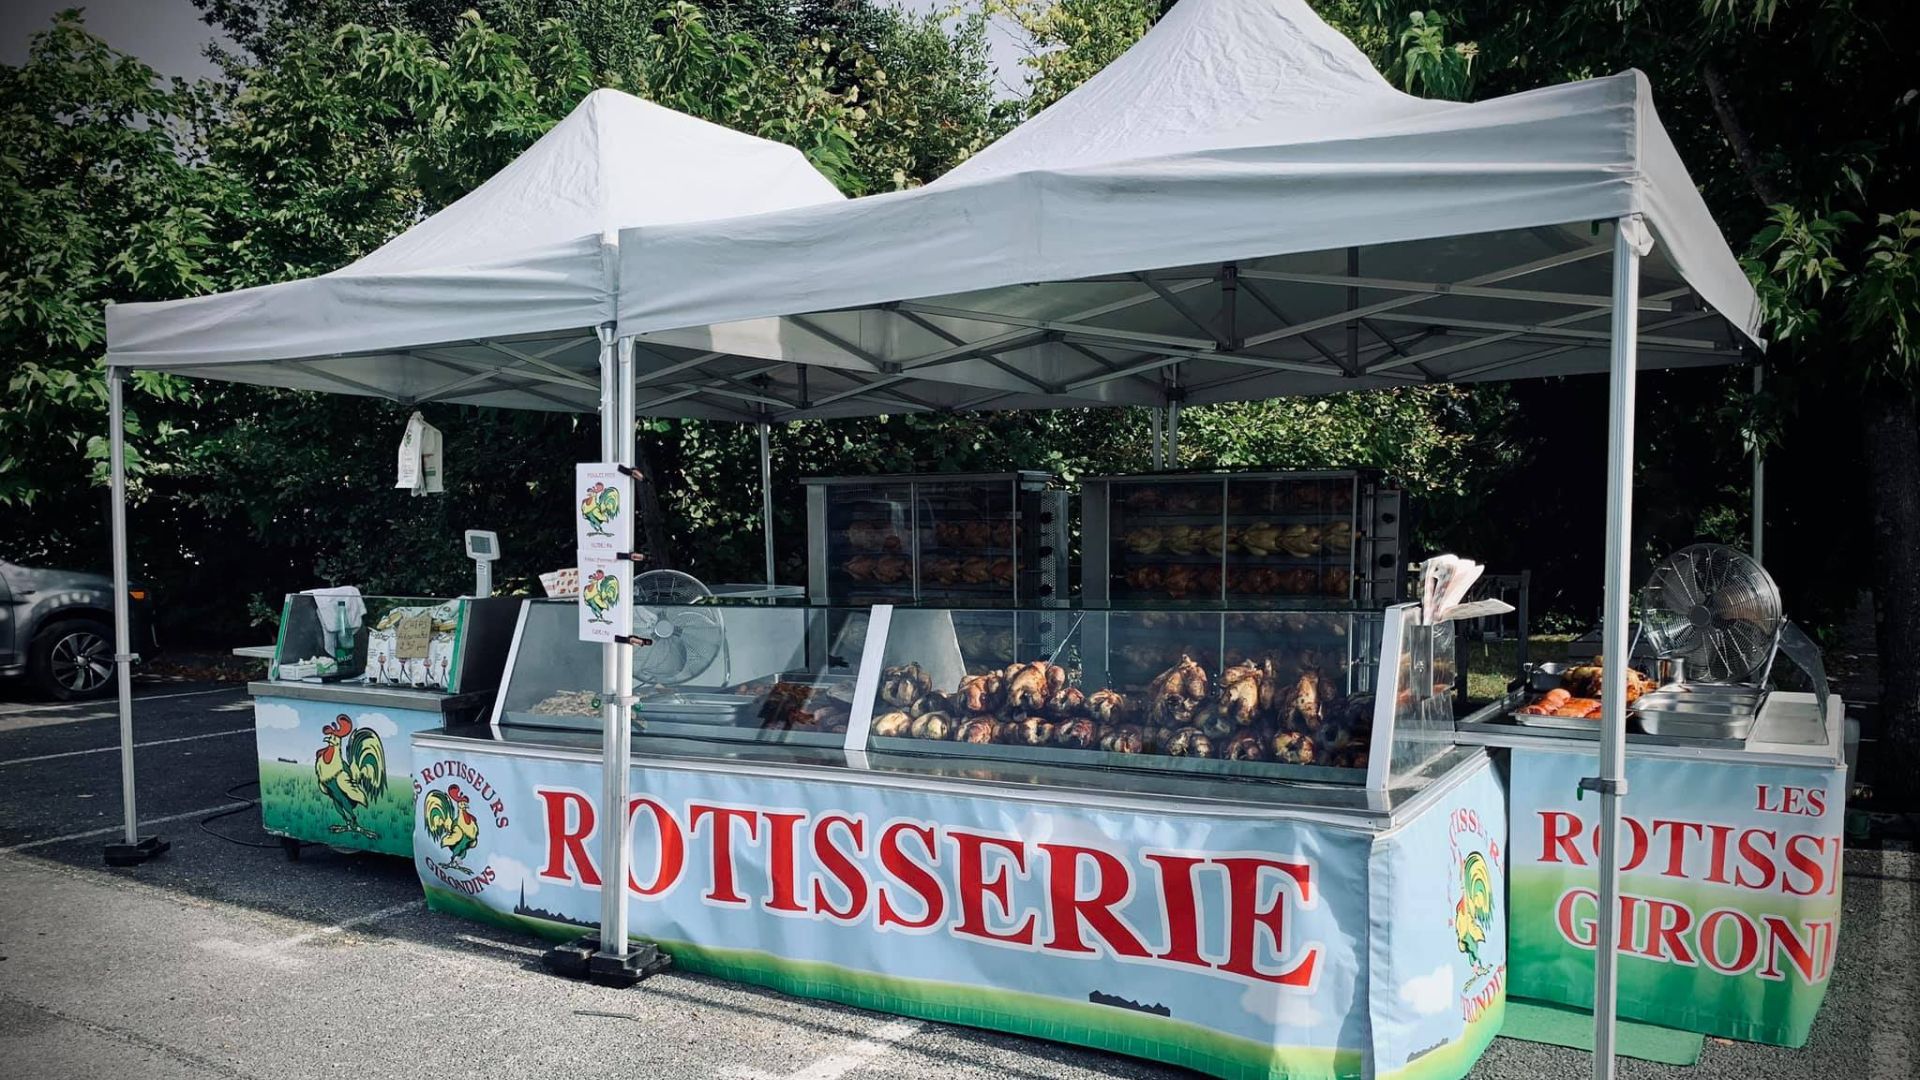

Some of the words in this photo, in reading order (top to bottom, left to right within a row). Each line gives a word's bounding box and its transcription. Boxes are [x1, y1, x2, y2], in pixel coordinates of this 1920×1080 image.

[421, 760, 509, 829] ROTISSEURS
[1757, 785, 1826, 817] LES
[425, 856, 496, 895] GIRONDINS
[537, 790, 1318, 986] ROTISSERIE
